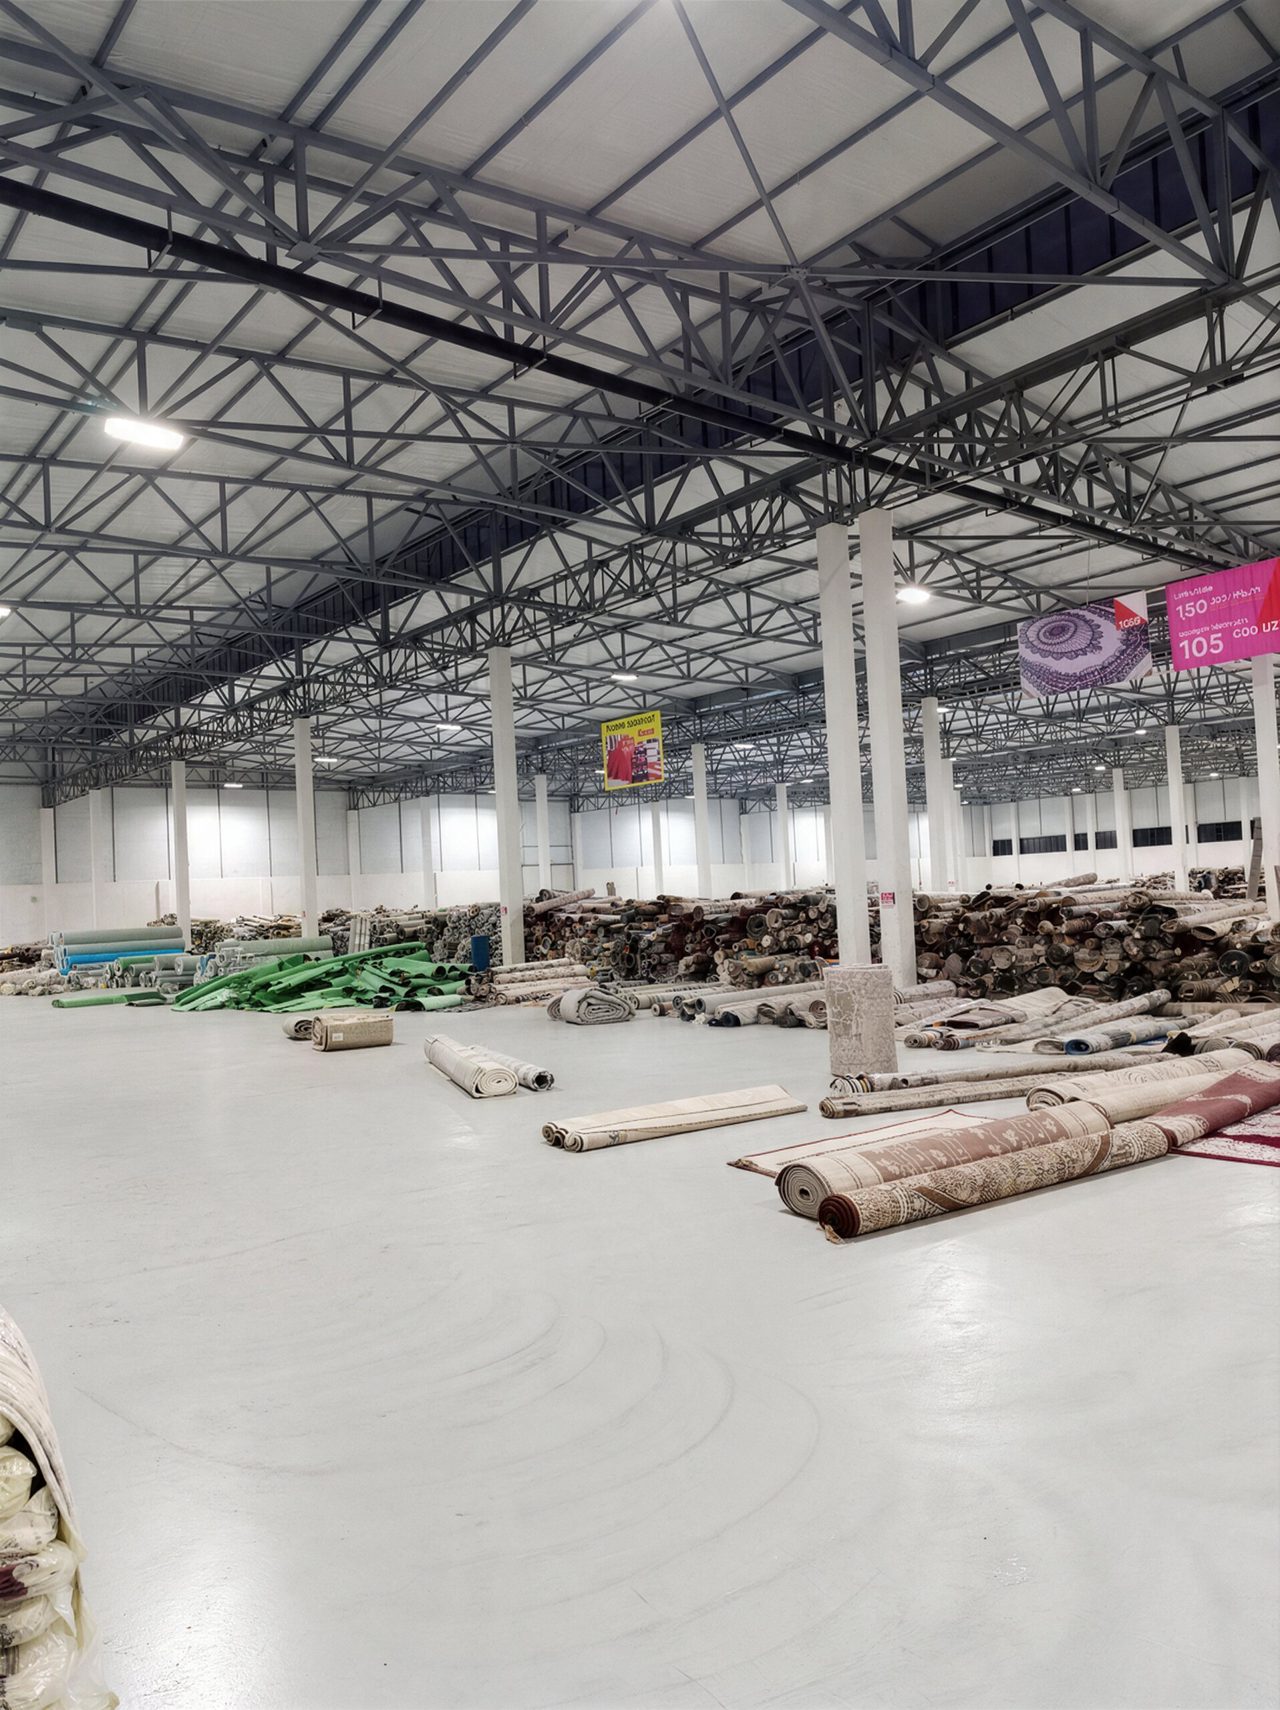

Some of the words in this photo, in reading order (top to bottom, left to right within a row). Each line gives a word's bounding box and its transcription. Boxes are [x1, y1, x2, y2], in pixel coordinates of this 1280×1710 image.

[1175, 599, 1208, 621] 150
[1179, 633, 1224, 660] 105
[1262, 619, 1280, 633] UZ
